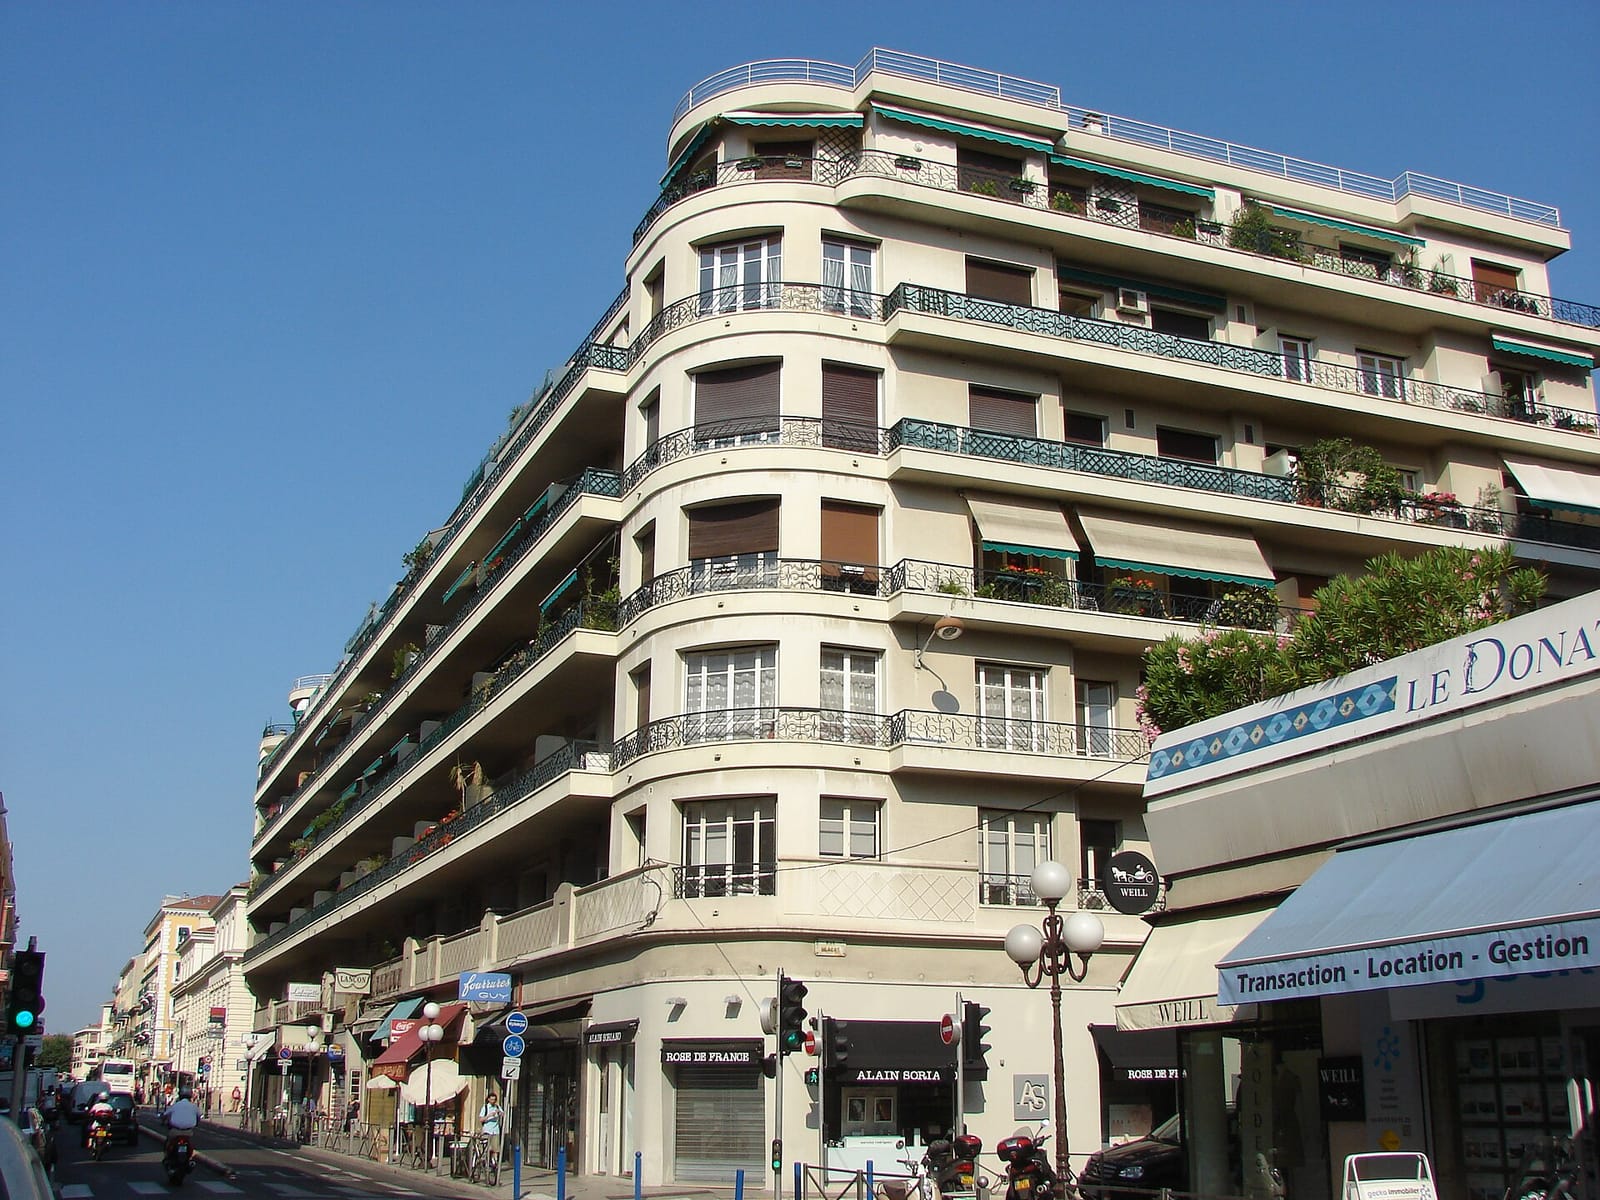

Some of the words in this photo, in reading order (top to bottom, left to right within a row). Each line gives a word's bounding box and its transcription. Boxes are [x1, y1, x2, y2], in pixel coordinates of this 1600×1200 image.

[1405, 669, 1451, 714] LE
[1120, 887, 1149, 897] WEILL
[1237, 964, 1346, 993] Transaction
[1367, 949, 1463, 978] Location
[1489, 934, 1589, 964] Gestion
[478, 991, 509, 999] GUY
[1158, 1000, 1208, 1022] WEILL
[666, 1052, 692, 1062] ROSE
[694, 1052, 707, 1062] DE
[709, 1052, 750, 1062] FRANCE
[857, 1070, 900, 1080] ALAIN
[902, 1070, 958, 1080] SORIA
[1128, 1069, 1153, 1079] ROSE
[1154, 1069, 1167, 1079] DE
[1320, 1069, 1360, 1082] WEILL
[1388, 1187, 1419, 1195] immobilier
